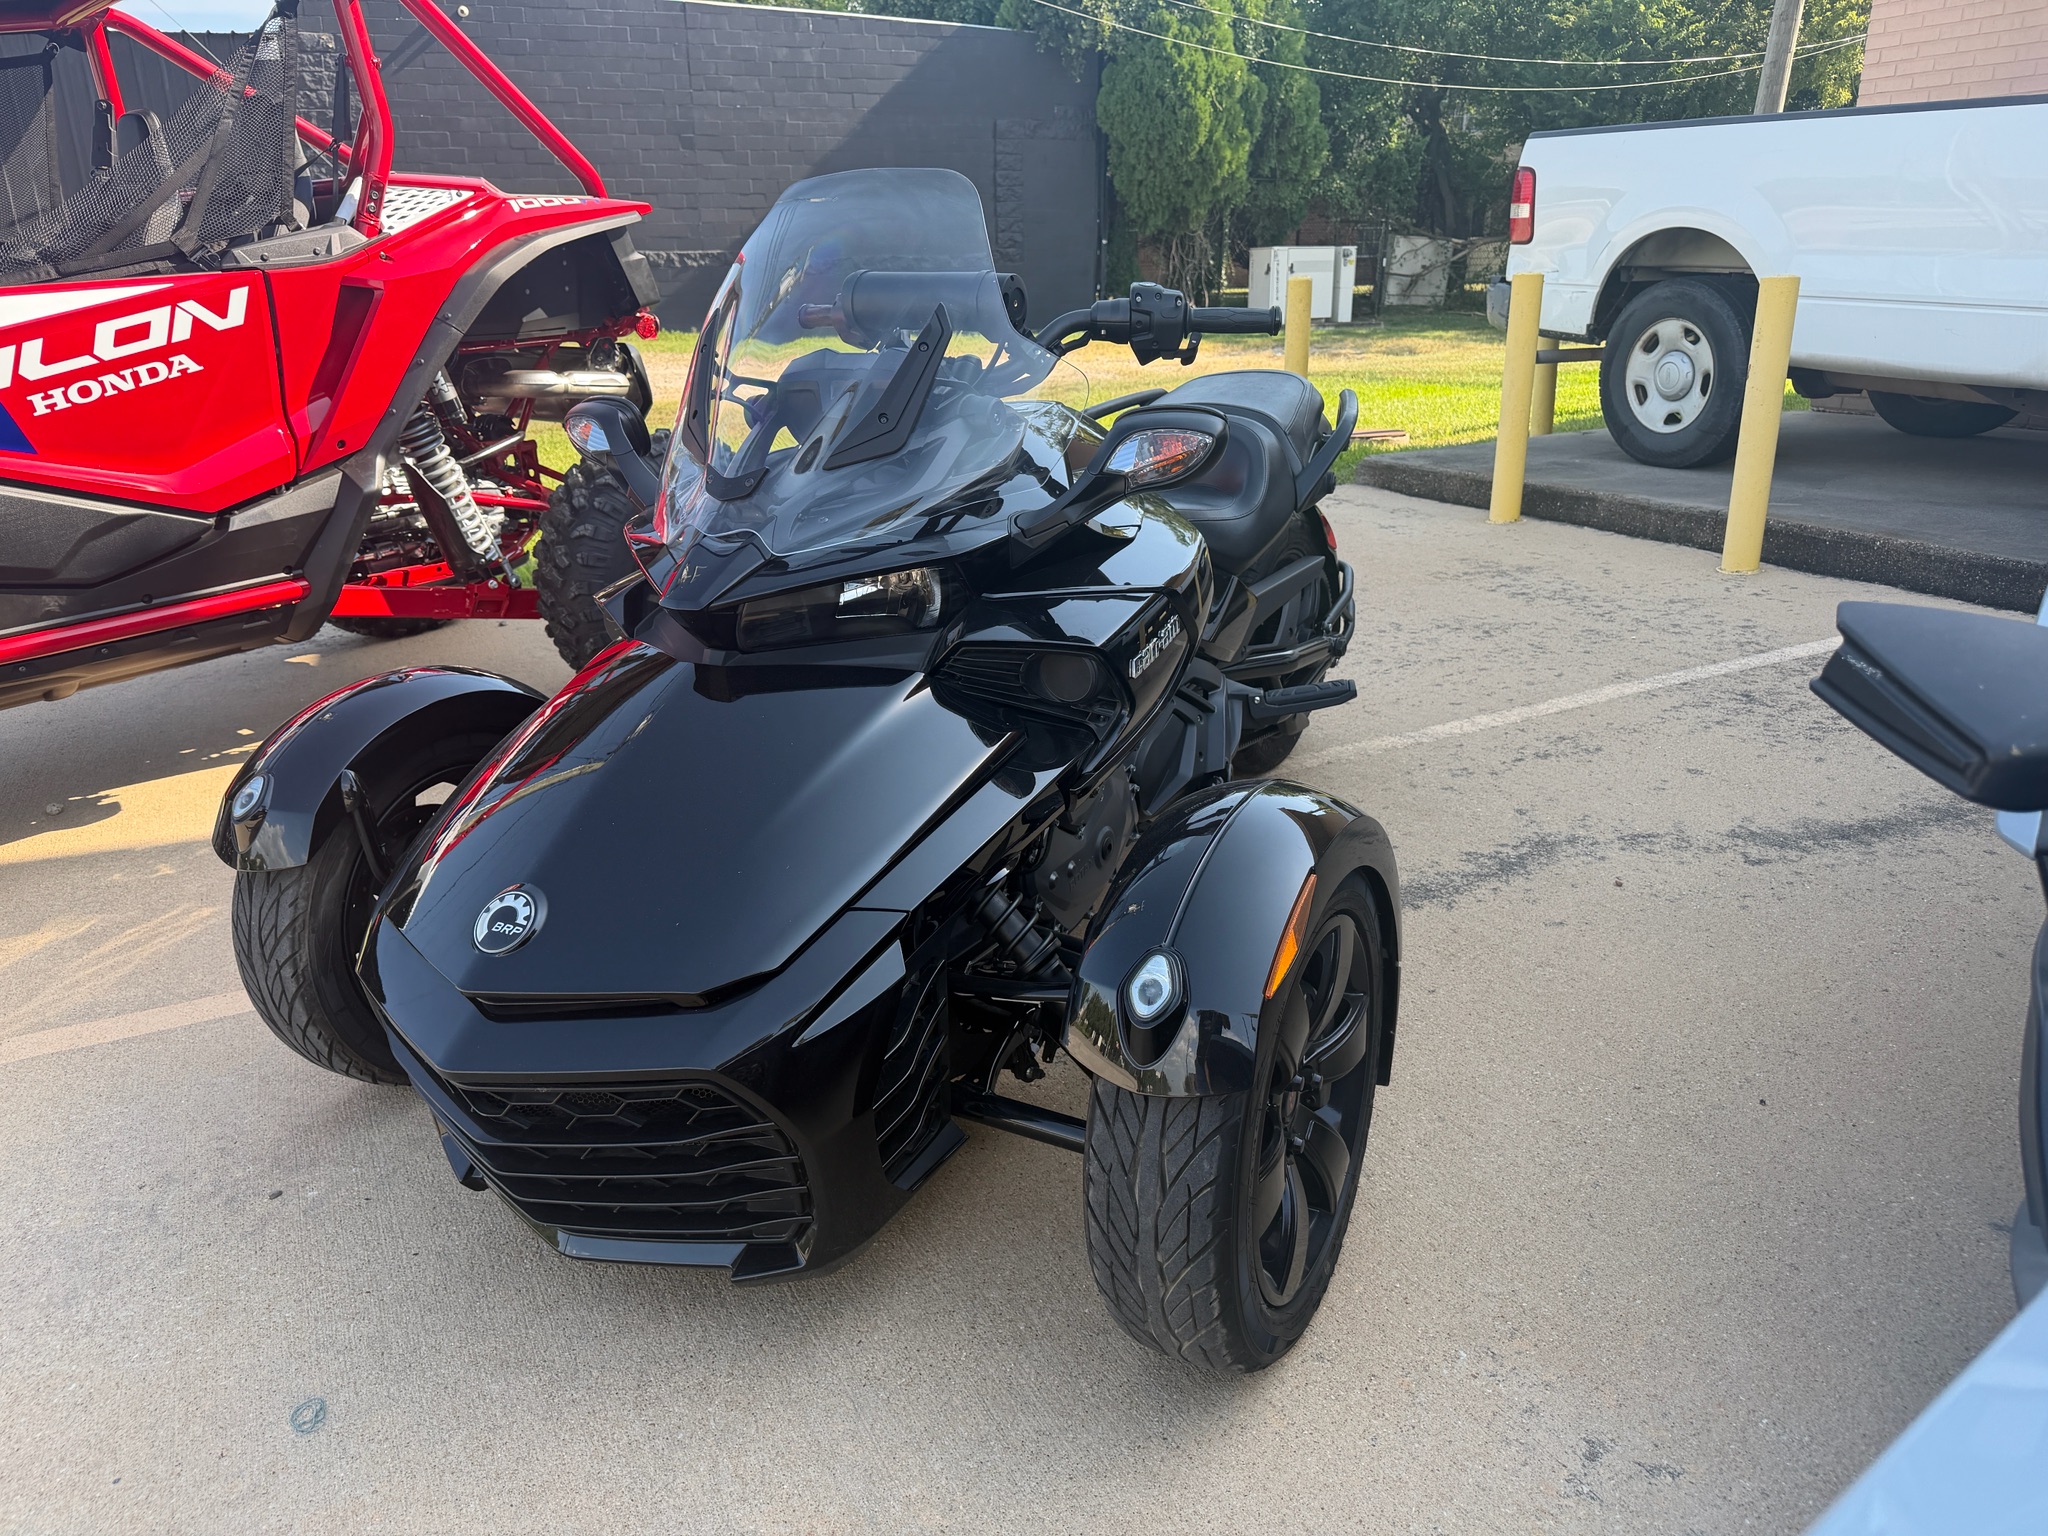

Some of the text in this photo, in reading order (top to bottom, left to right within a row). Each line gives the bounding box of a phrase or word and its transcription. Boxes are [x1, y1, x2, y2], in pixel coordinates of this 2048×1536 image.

[0, 286, 249, 390] LON
[26, 353, 204, 417] HONDA
[491, 921, 523, 936] BRP
